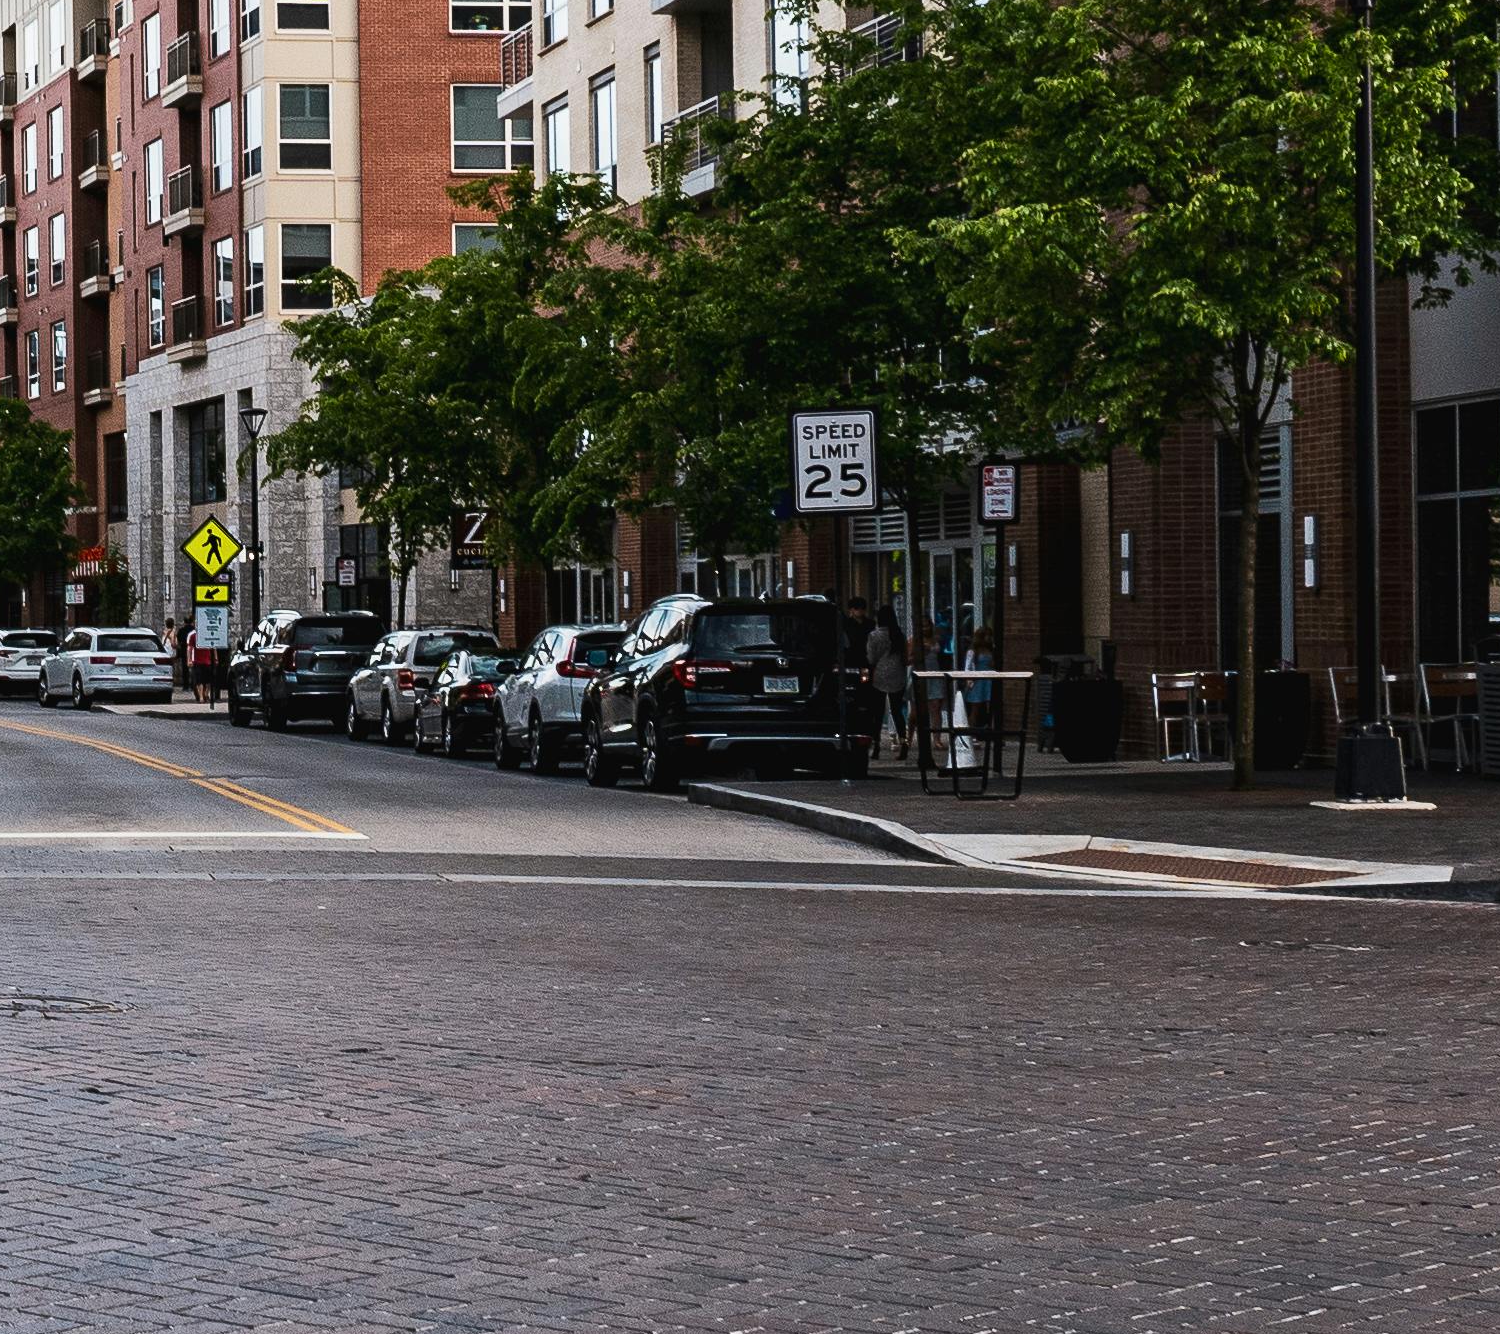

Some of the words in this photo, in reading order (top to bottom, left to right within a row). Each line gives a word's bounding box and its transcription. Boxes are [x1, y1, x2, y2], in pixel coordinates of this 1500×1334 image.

[802, 423, 866, 441] SPEED
[809, 443, 860, 460] LIMIT
[804, 462, 868, 499] 25
[463, 512, 488, 544] Z
